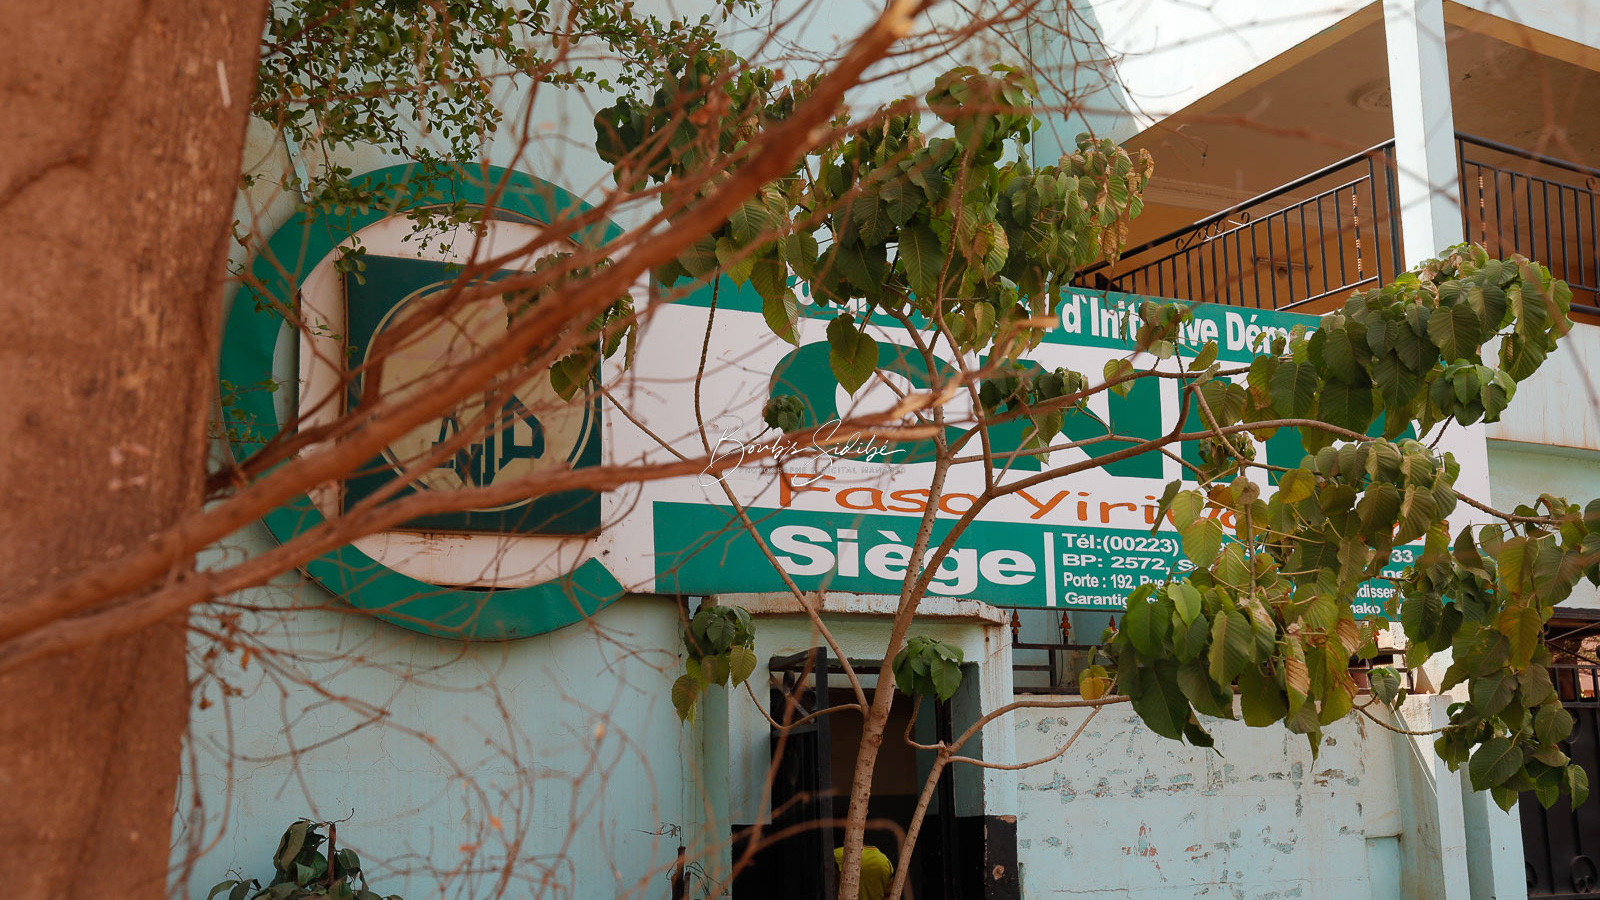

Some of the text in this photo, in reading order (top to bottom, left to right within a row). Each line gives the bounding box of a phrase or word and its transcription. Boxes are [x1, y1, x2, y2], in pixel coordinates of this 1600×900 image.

[779, 473, 981, 516] Faso
[1062, 533, 1179, 557] Tél:(00223)
[769, 525, 1037, 596] Siège
[1062, 553, 1103, 568] BP:
[1110, 556, 1172, 575] 2572,
[1063, 572, 1099, 588] Porte
[1110, 574, 1137, 591] 192,
